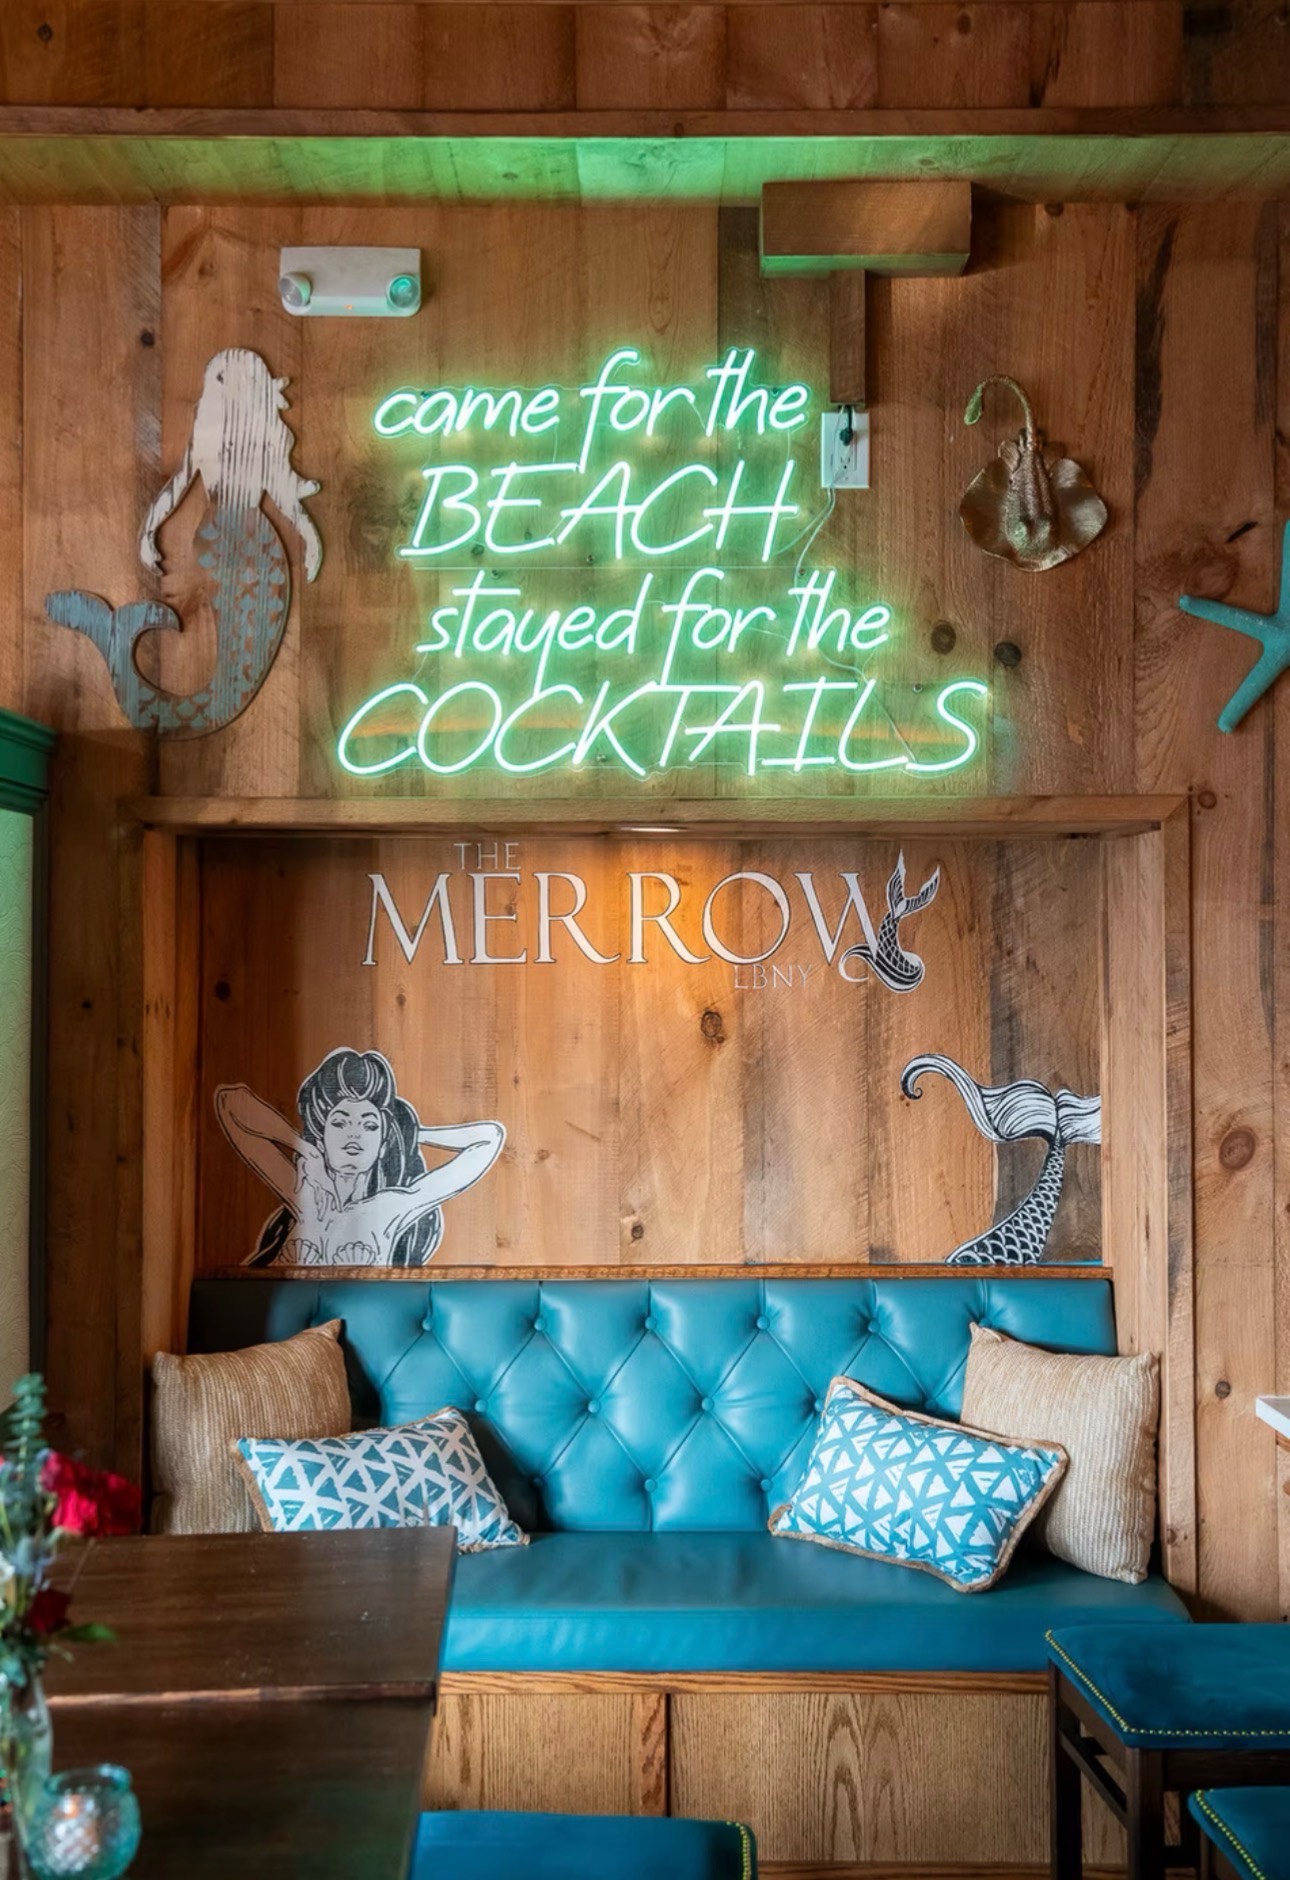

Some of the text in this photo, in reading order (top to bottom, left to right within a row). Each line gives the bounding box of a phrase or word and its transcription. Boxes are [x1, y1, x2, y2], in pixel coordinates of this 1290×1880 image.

[373, 347, 810, 473] came for the
[399, 459, 799, 562] BEACH
[415, 567, 892, 700] stayed for the
[336, 677, 990, 777] COCKTAILS
[454, 841, 521, 870] THE
[361, 866, 940, 970] MERROW
